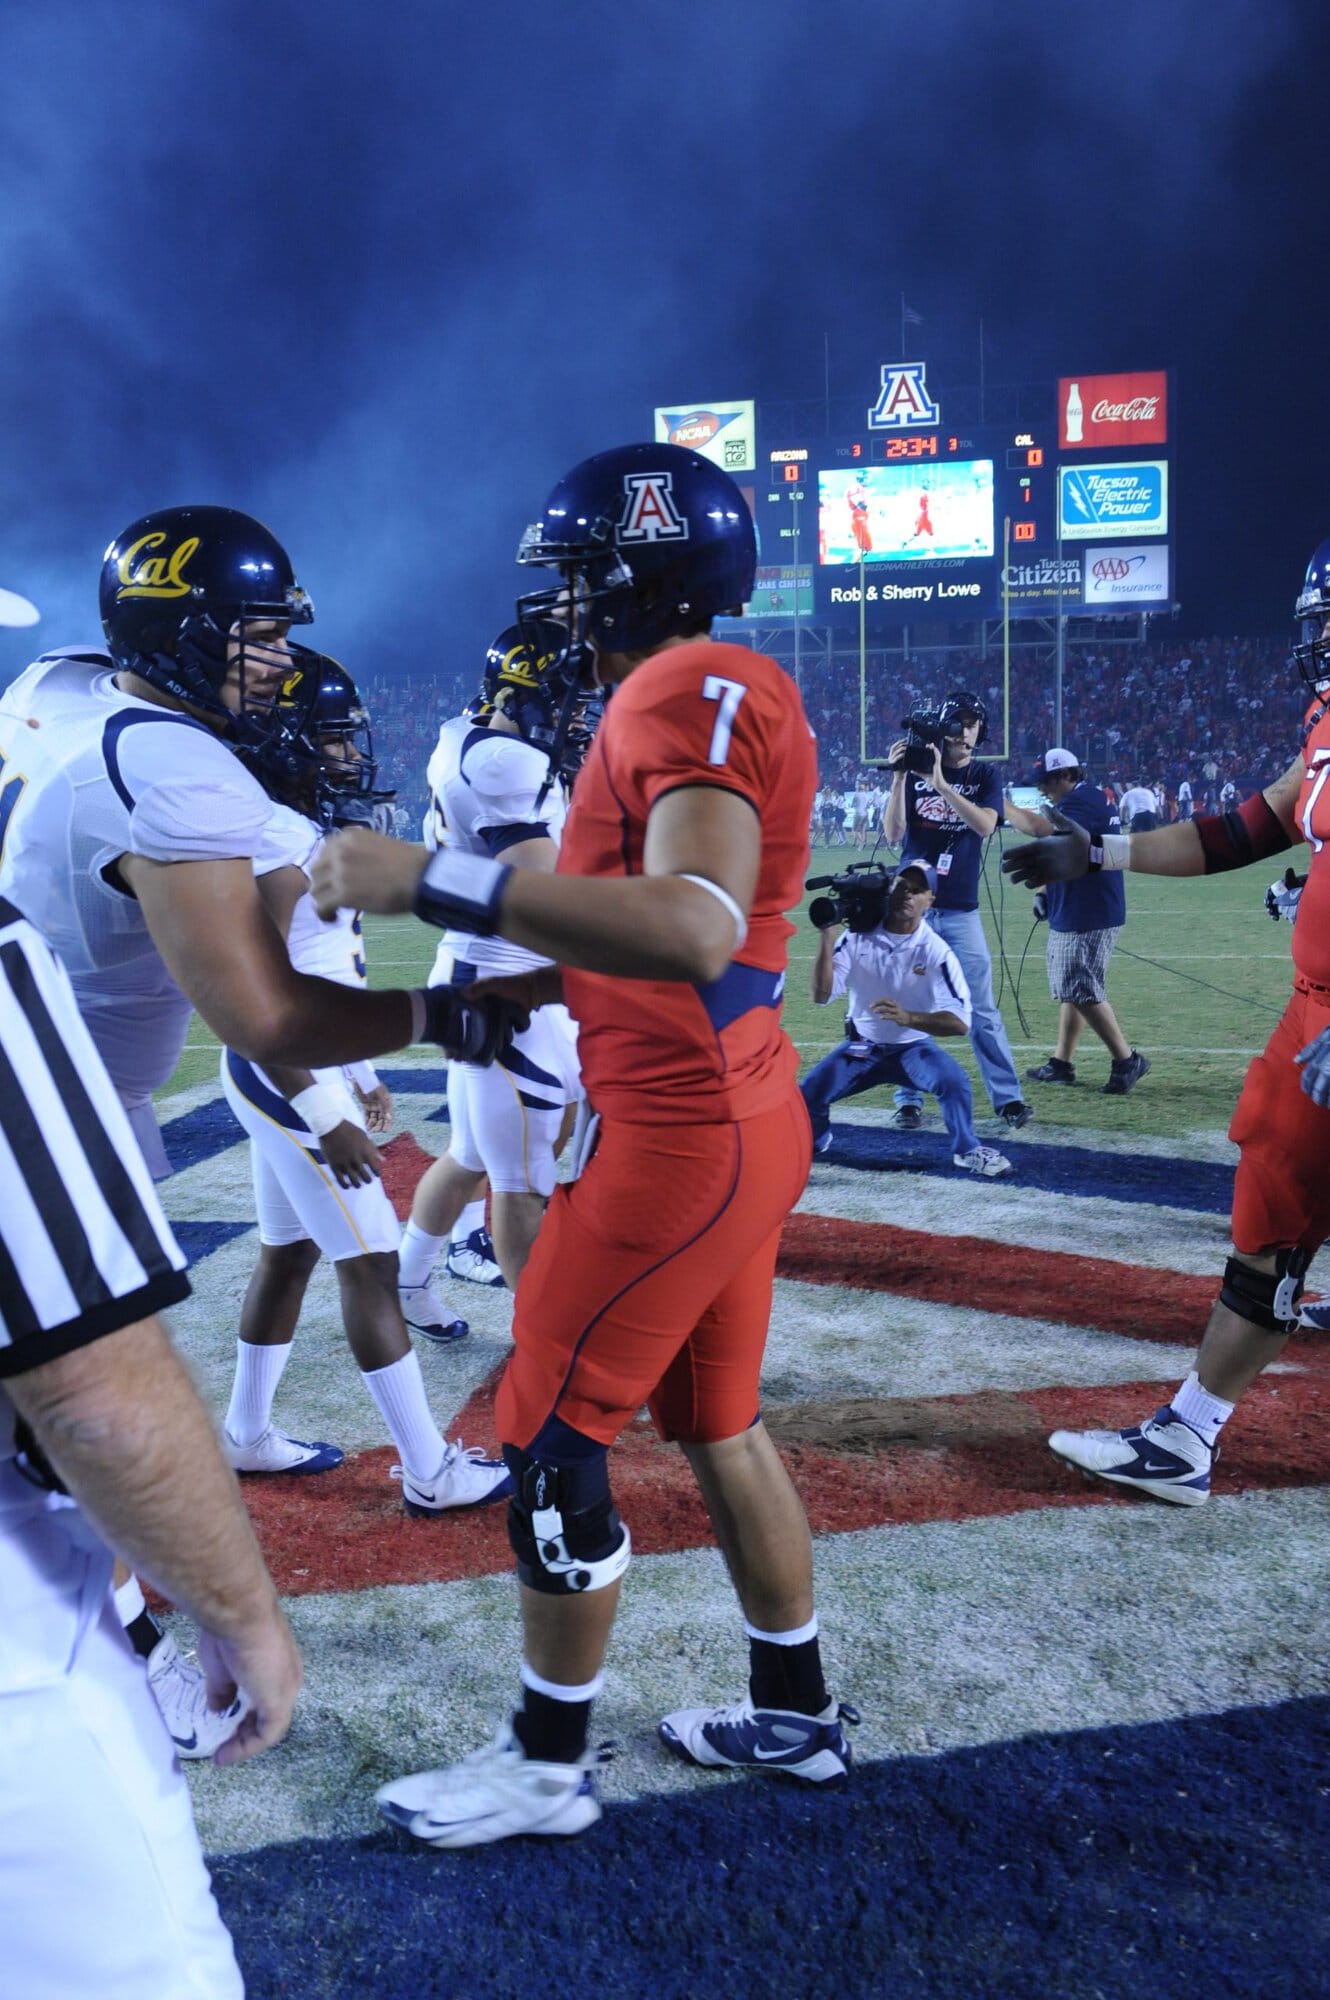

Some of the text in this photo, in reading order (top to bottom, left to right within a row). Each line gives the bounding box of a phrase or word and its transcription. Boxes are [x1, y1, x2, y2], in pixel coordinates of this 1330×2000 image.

[868, 362, 940, 430] A
[675, 426, 711, 442] NCAA
[1015, 434, 1034, 446] CAL
[771, 450, 808, 461] ARIZONA
[852, 444, 861, 457] 3
[886, 436, 937, 458] 2:34
[949, 438, 957, 450] 3
[1087, 475, 1138, 490] Tucson
[1092, 487, 1152, 502] Electric
[615, 472, 689, 545] A
[1098, 502, 1152, 516] Power
[115, 531, 200, 599] Cal
[1039, 559, 1080, 569] Tucson
[1093, 558, 1129, 580] AAA
[1001, 563, 1081, 586] Citizen
[831, 582, 981, 602] Rob & Sherry Lowe
[1111, 583, 1163, 593] Insurance
[702, 674, 749, 767] 7
